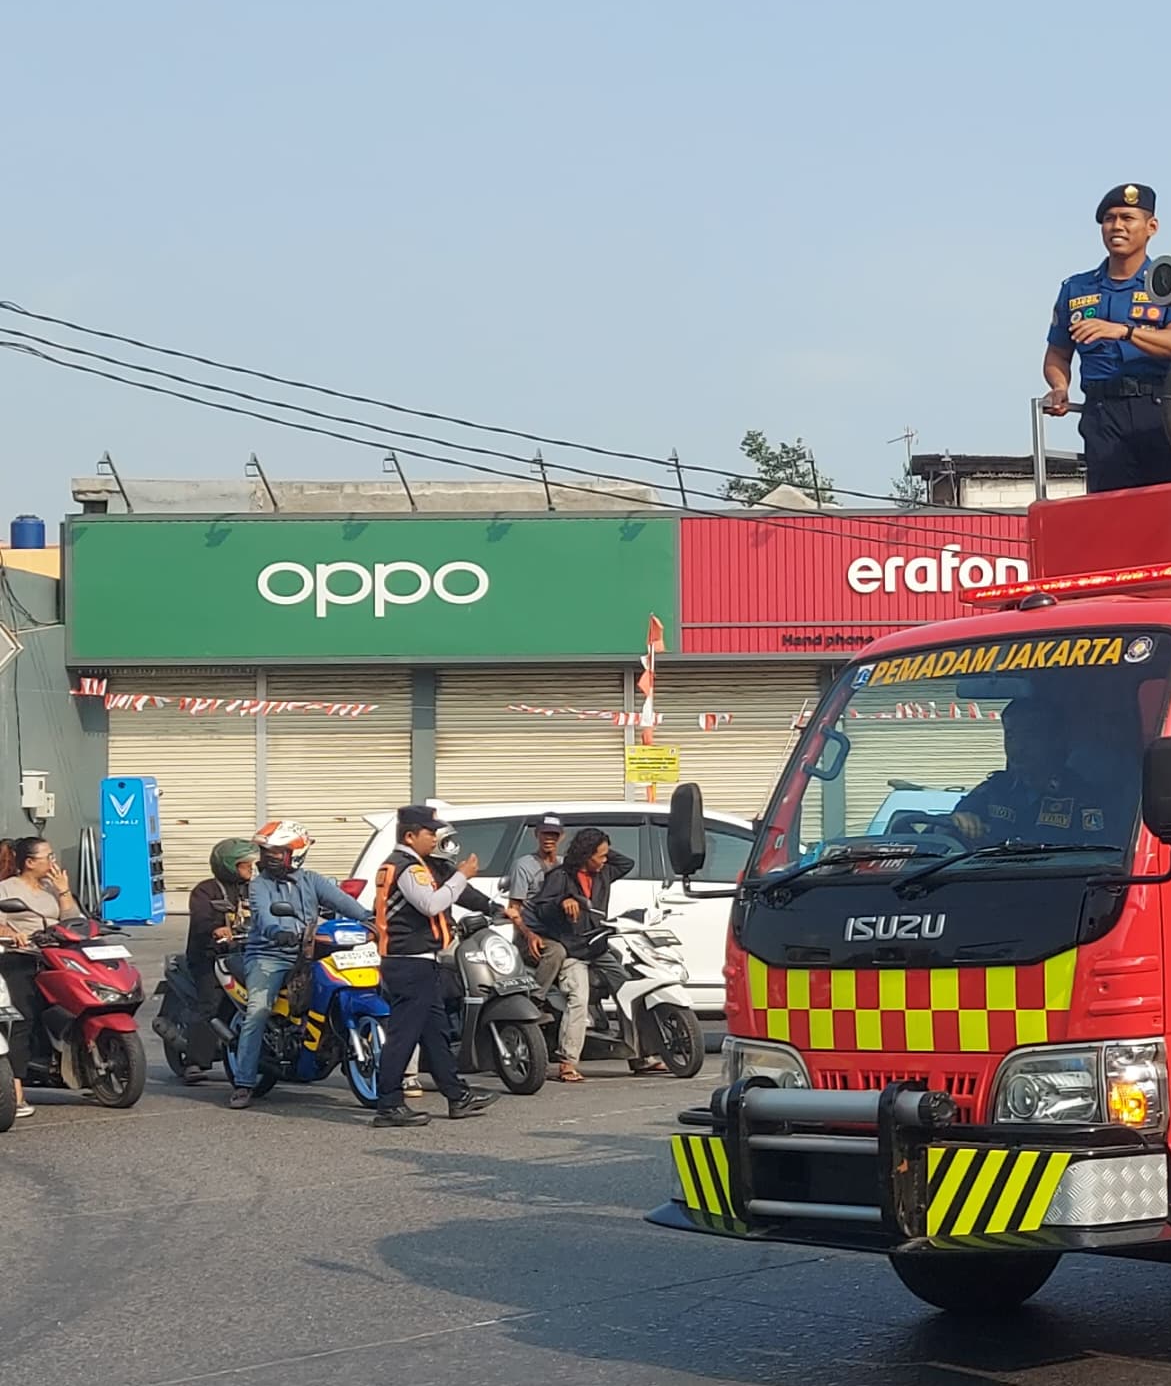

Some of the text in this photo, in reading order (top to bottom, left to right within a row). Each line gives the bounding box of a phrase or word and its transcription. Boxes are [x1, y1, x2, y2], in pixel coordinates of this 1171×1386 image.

[257, 561, 489, 618] oppo
[847, 544, 1028, 593] erafon
[782, 634, 822, 646] Hand
[868, 637, 1123, 686] PEMADAM JAKARTA
[844, 914, 946, 941] ISUZU
